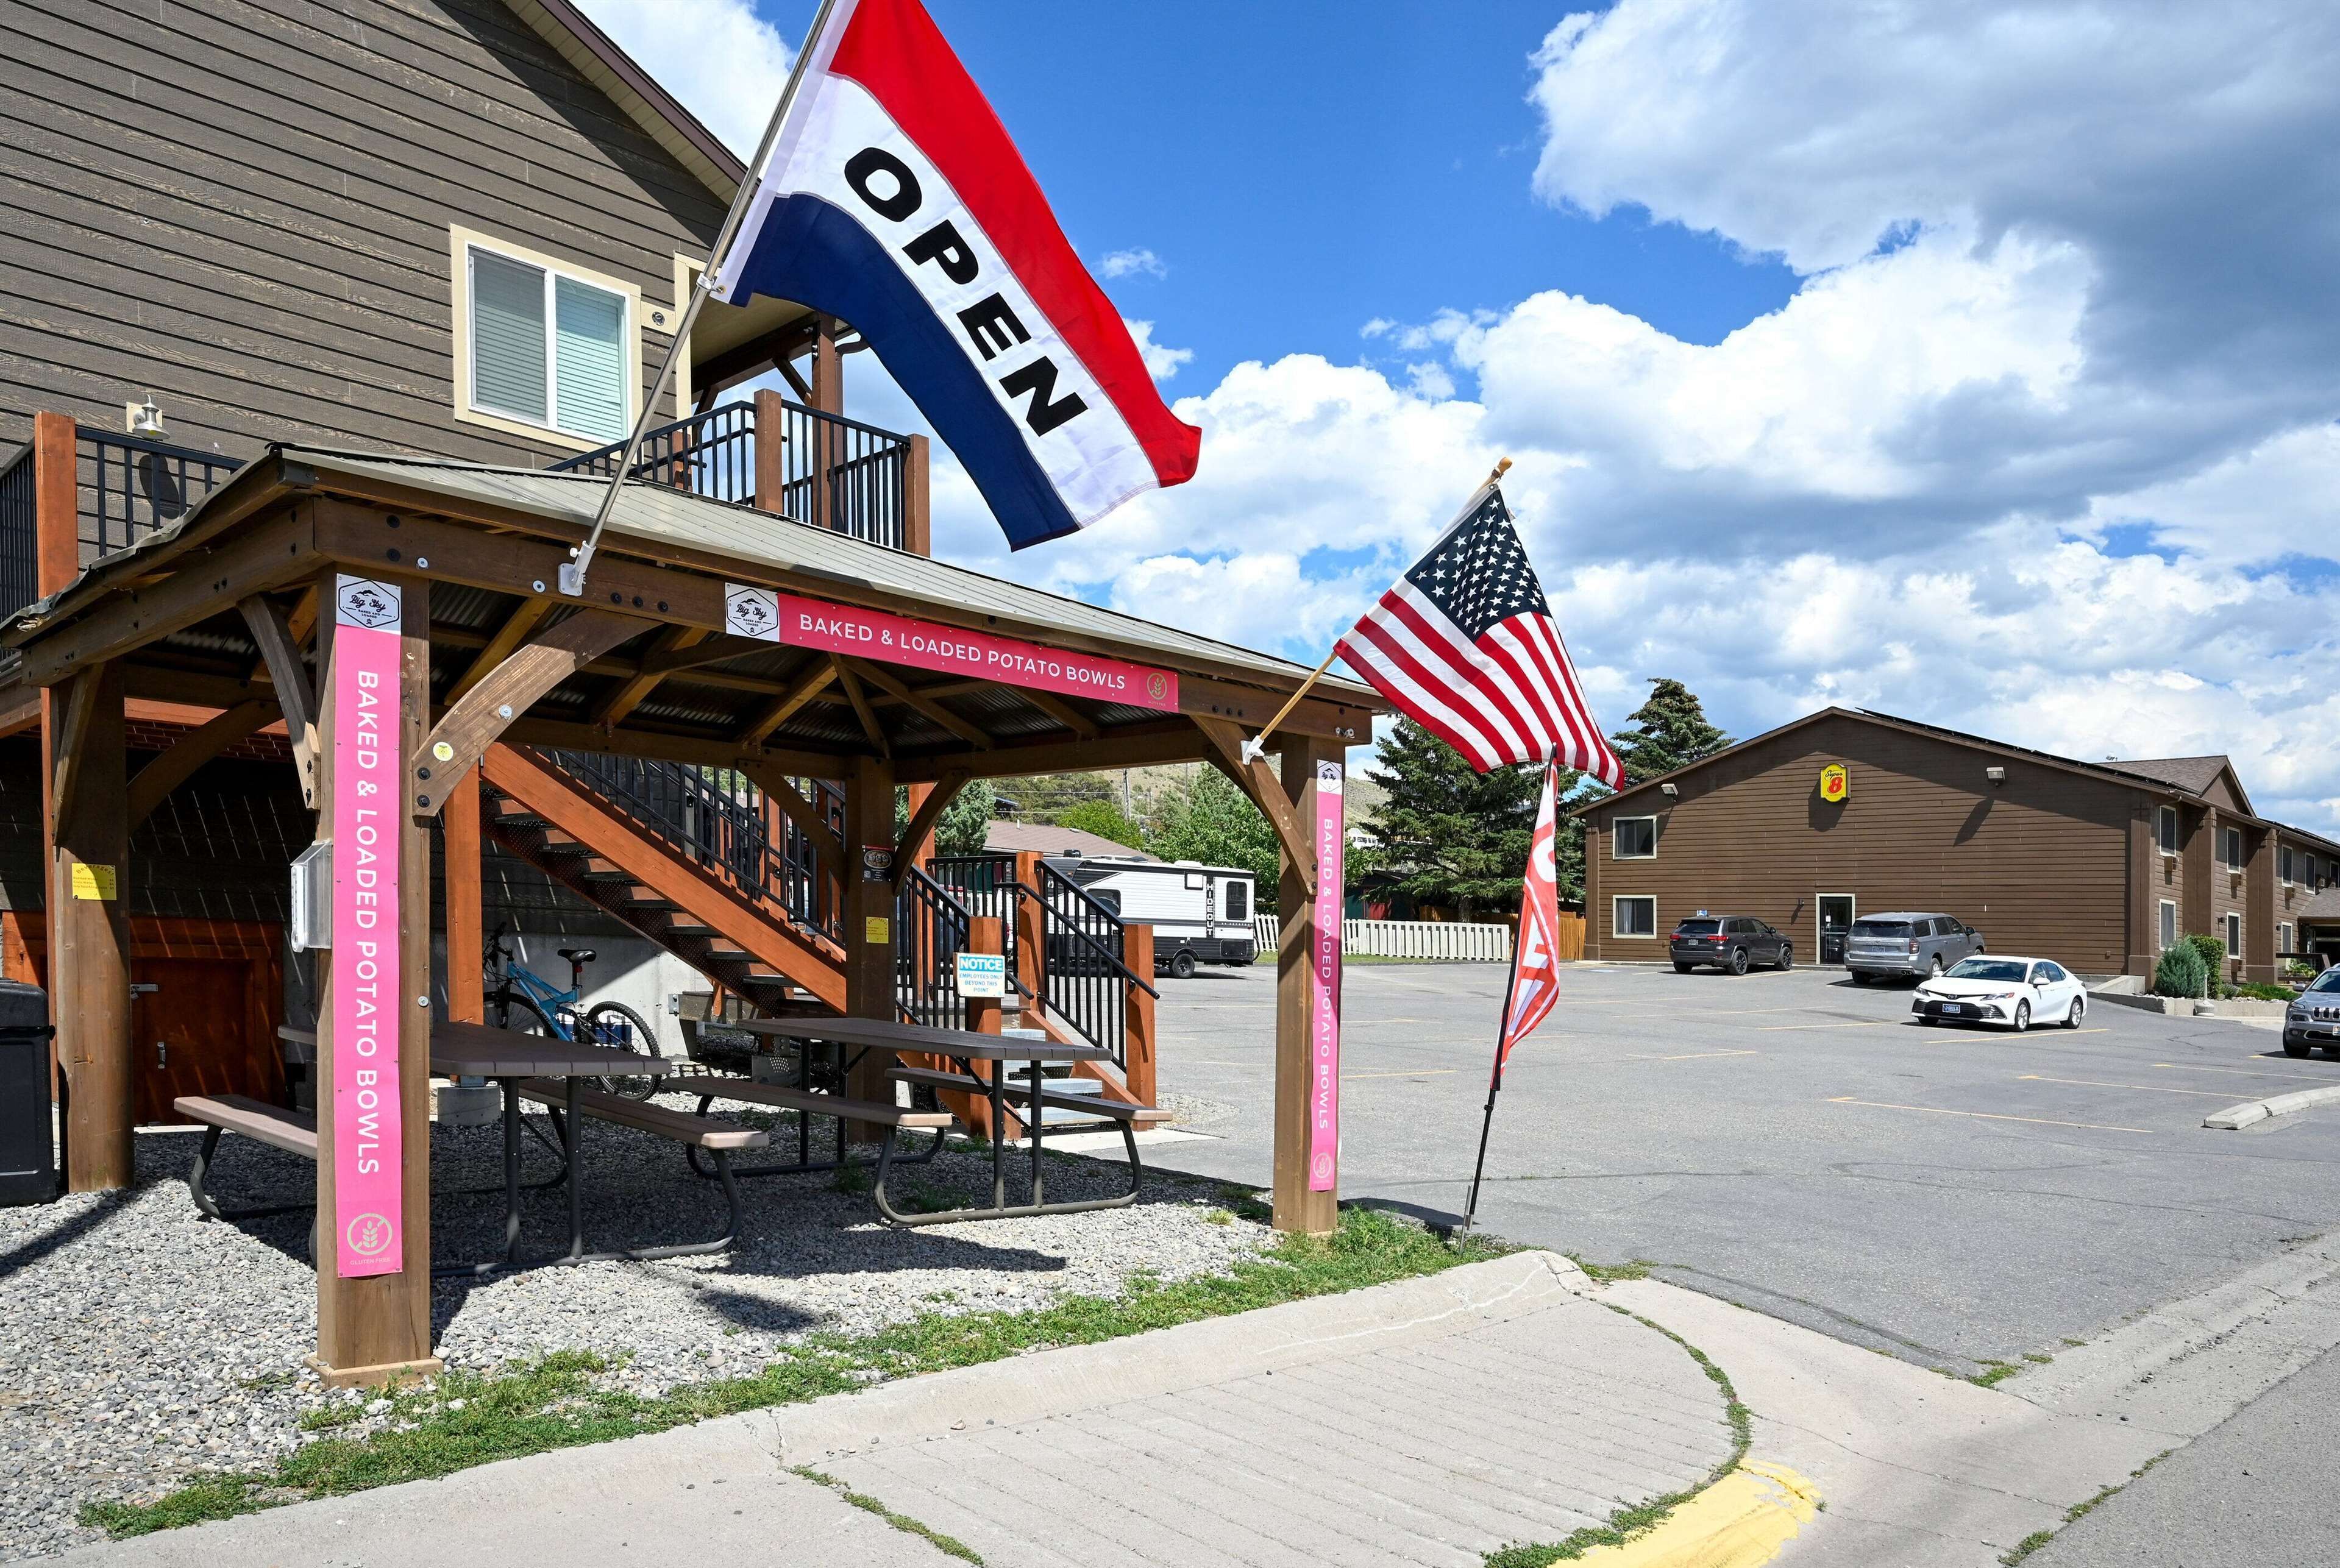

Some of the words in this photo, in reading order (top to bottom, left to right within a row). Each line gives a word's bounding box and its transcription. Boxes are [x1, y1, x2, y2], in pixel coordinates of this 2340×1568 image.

[844, 147, 1089, 437] OPEN
[349, 595, 366, 608] Big
[369, 598, 386, 612] Sky
[736, 603, 750, 617] Big
[753, 606, 767, 620] Sky
[800, 614, 873, 642] BAKED
[881, 630, 893, 645] &
[900, 633, 981, 662] LOADED
[987, 650, 1061, 676] POTATO
[1066, 665, 1125, 690] BOWLS
[357, 670, 378, 769] BAKED
[357, 779, 378, 796] &
[1825, 770, 1843, 779] Super
[1827, 776, 1843, 794] 8
[356, 810, 378, 929] LOADED
[1323, 818, 1333, 879] BAKED
[1323, 887, 1332, 897] &
[960, 957, 1003, 971] NOTICE
[1322, 904, 1332, 978] LOADED
[356, 941, 378, 1057] POTATO
[1321, 986, 1331, 1057] POTATO
[357, 1070, 379, 1174] BOWLS
[1319, 1065, 1329, 1129] BOWLS
